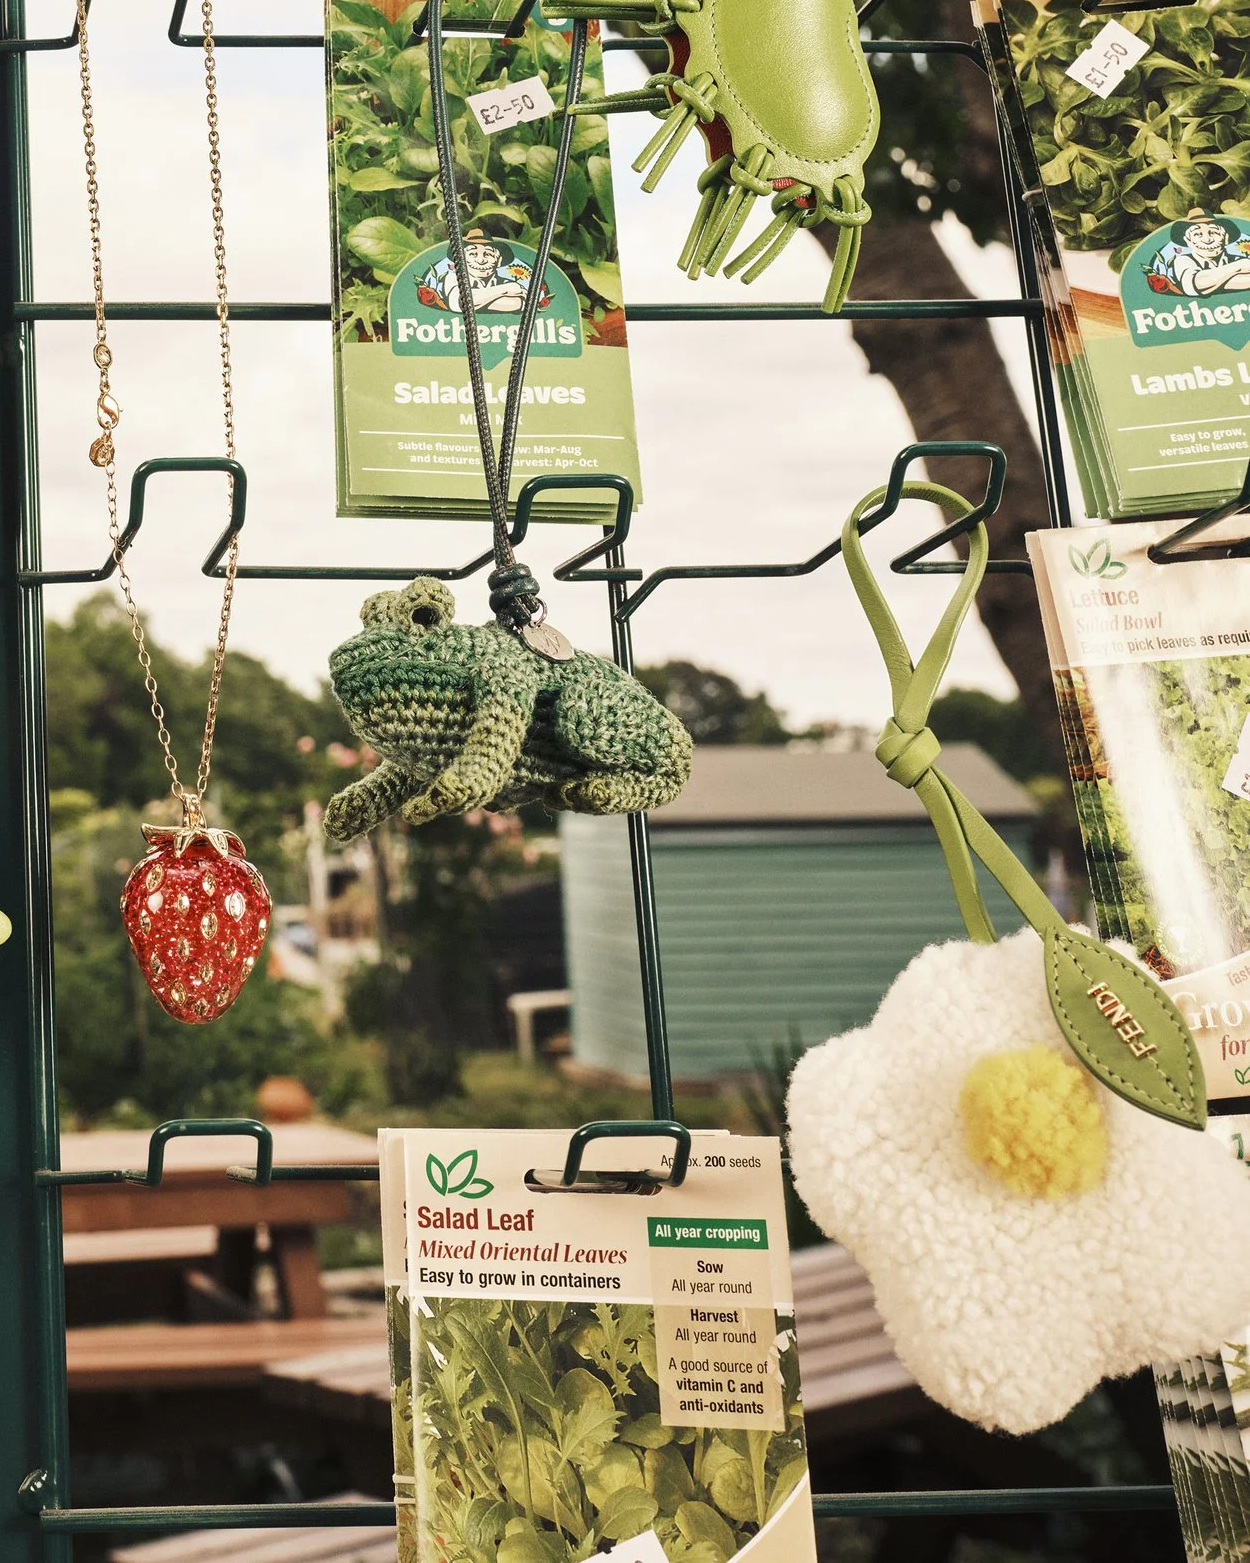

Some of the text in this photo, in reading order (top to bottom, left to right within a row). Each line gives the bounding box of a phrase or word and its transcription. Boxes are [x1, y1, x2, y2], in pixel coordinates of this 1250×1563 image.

[1084, 42, 1128, 89] £1-50
[479, 94, 535, 125] £2-50
[1132, 300, 1250, 335] Fother
[1131, 365, 1234, 396] Lambs
[394, 381, 475, 405] Salad
[397, 442, 480, 453] Subtle flavours
[534, 446, 582, 456] Mar-Aug
[1159, 440, 1250, 457] versatile leaves
[433, 455, 481, 465] textures
[555, 458, 599, 468] Apr-Oct
[1069, 589, 1140, 608] Lettuce
[1123, 612, 1163, 631] Bowl
[1156, 635, 1215, 651] leaves as
[1087, 982, 1158, 1060] FENDI
[704, 1155, 761, 1168] 200 seeds
[417, 1206, 535, 1231] Salad Leaf
[655, 1224, 761, 1242] All year cropping
[418, 1239, 628, 1265] Mixed Oriental Leaves
[697, 1260, 724, 1274] Sow
[419, 1268, 621, 1290] Easy to grow in containers
[671, 1279, 752, 1295] All year round
[690, 1308, 739, 1323] Harvest
[675, 1328, 756, 1344] All year round
[680, 1359, 768, 1375] good source of
[676, 1378, 764, 1394] vitamin and
[679, 1398, 764, 1415] anti-oxidants
